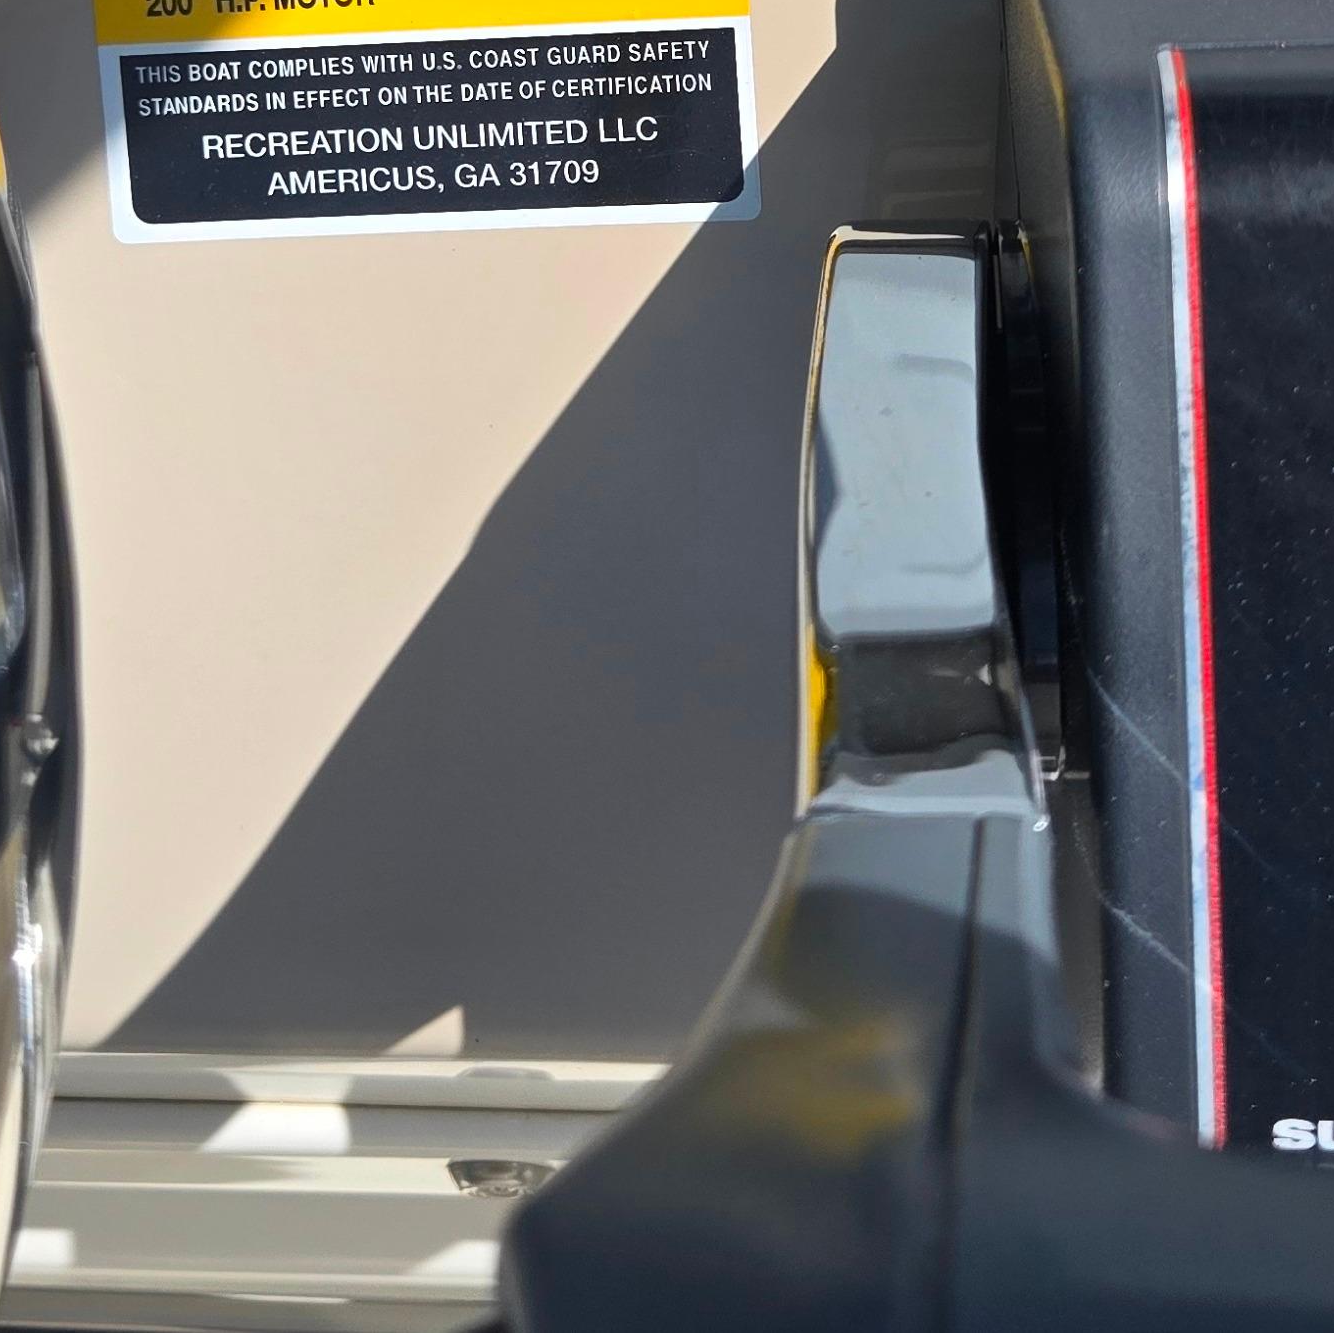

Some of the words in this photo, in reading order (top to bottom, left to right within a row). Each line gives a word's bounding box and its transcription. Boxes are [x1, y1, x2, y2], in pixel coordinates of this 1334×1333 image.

[135, 64, 181, 84] THIS
[189, 61, 240, 82] BOAT
[248, 56, 354, 80] COMPLIES
[361, 53, 412, 74] WITH
[422, 51, 462, 71] U.S.
[468, 47, 539, 68] COAST
[547, 44, 621, 65] GUARD
[628, 40, 709, 62] SAFETY
[139, 92, 259, 117] STANDARDS
[266, 91, 286, 111] IN
[294, 87, 371, 109] EFFECT
[378, 86, 407, 105] ON
[412, 84, 453, 104] THE
[461, 82, 513, 102] DATE
[518, 80, 546, 99] OF
[551, 73, 712, 98] CERTIFICATION
[202, 126, 403, 159] RECREATION
[413, 119, 588, 150] UNLIMITED
[599, 116, 658, 142] LLC
[267, 166, 445, 196] AMERICUS,
[455, 163, 501, 187] GA
[509, 159, 599, 186] 31709
